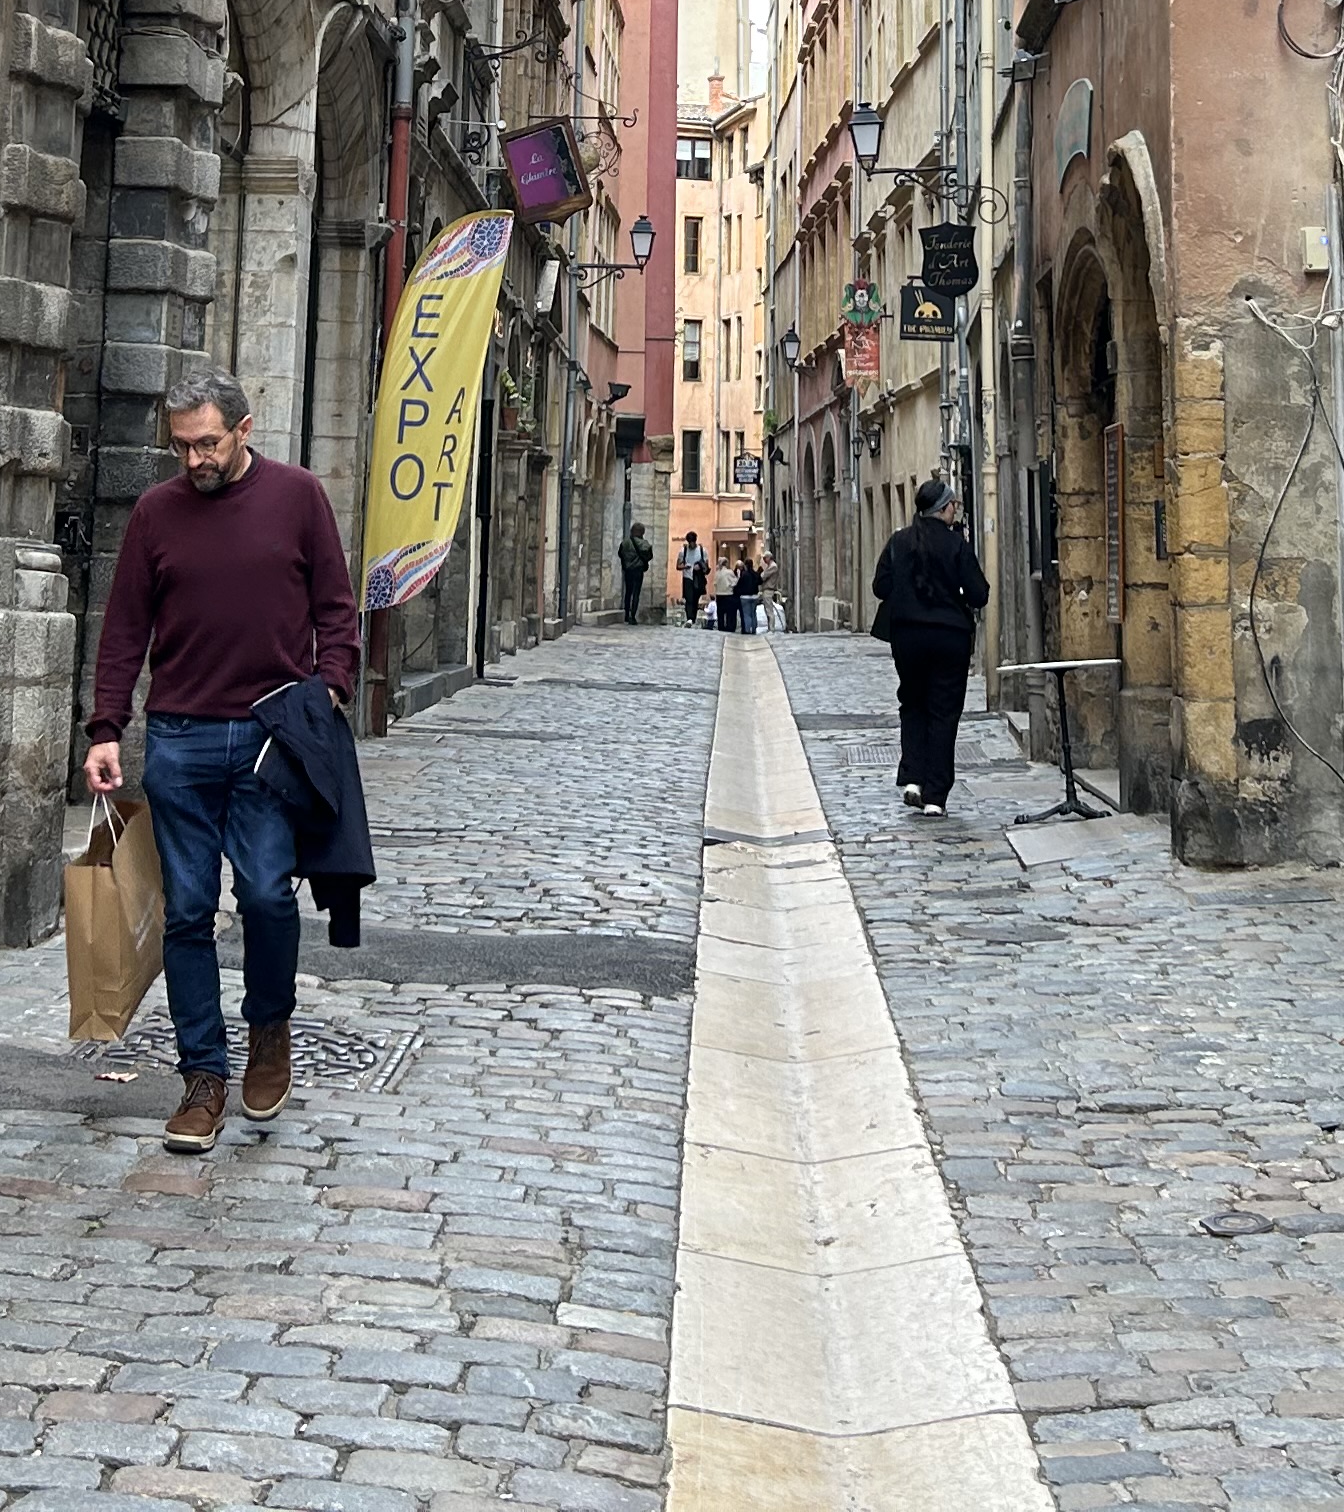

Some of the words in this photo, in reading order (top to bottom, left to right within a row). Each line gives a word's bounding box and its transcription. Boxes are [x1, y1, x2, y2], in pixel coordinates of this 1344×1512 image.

[529, 152, 545, 166] La
[925, 232, 972, 251] Fonderie
[927, 252, 970, 269] d'Art
[927, 269, 973, 287] Thomas
[390, 294, 444, 501] EXPO
[432, 387, 466, 522] ART
